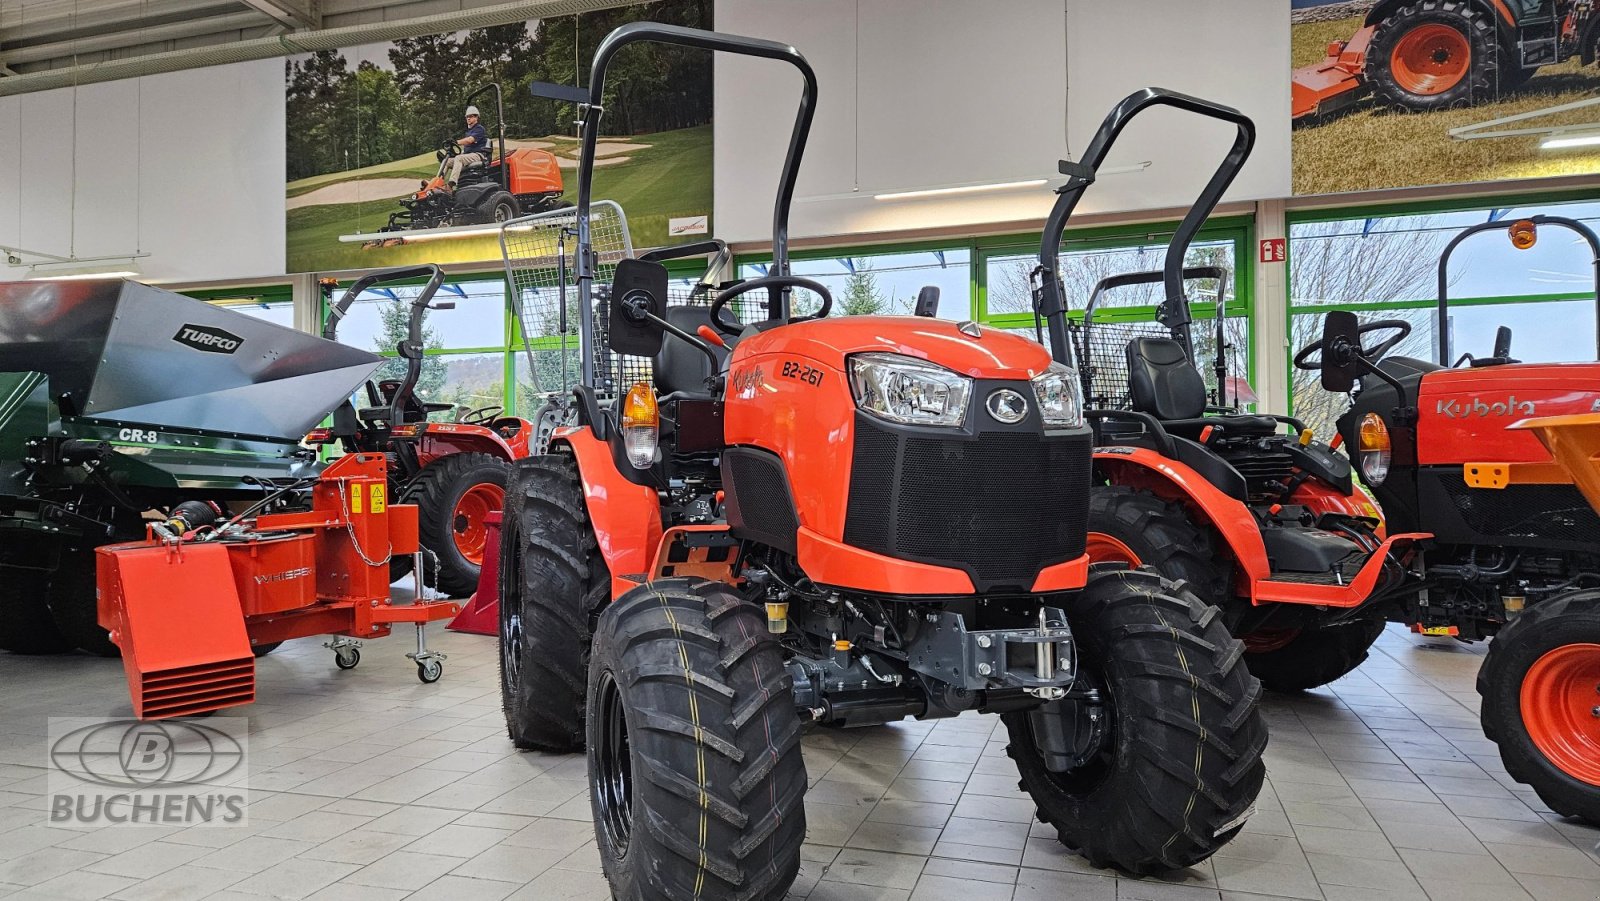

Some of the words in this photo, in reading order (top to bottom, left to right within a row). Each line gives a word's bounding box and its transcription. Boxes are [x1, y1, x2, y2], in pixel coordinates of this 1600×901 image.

[181, 328, 237, 350] TURFCO
[781, 361, 824, 387] B2-261
[1436, 395, 1535, 418] Kubota
[119, 428, 157, 443] CR-8
